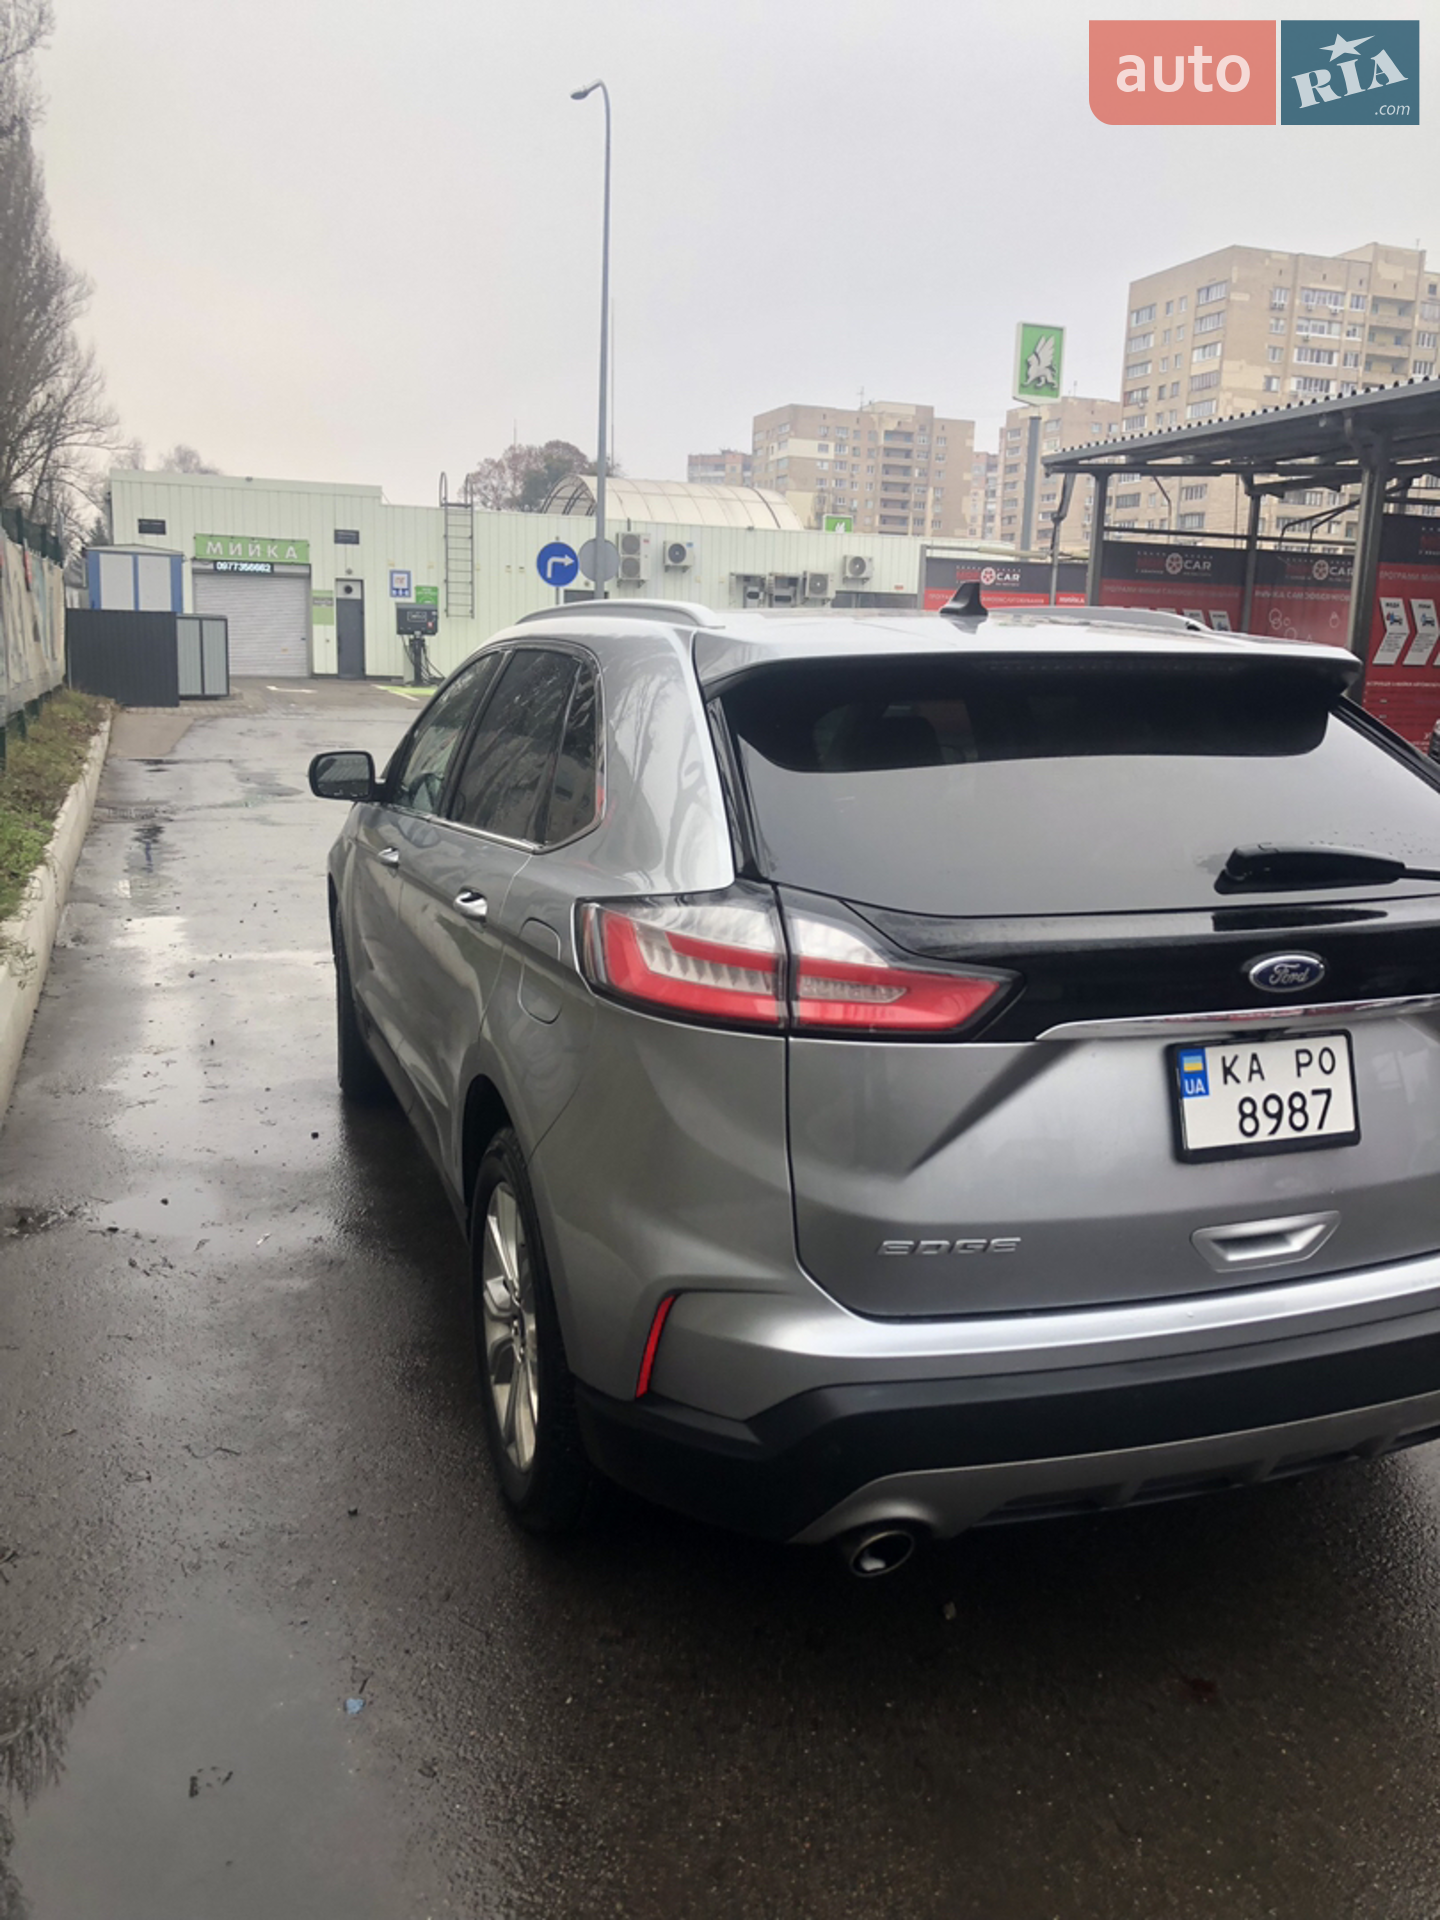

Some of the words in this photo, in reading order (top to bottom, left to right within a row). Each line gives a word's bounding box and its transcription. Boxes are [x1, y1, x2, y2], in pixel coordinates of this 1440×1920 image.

[206, 540, 298, 559] МИЙКА
[1184, 560, 1212, 571] CAR
[996, 572, 1020, 582] CAR
[1268, 963, 1309, 985] Ford
[1221, 1052, 1265, 1086] KA
[1184, 1078, 1206, 1095] UA
[1237, 1087, 1333, 1138] 8987
[878, 1236, 1022, 1256] EDGE
